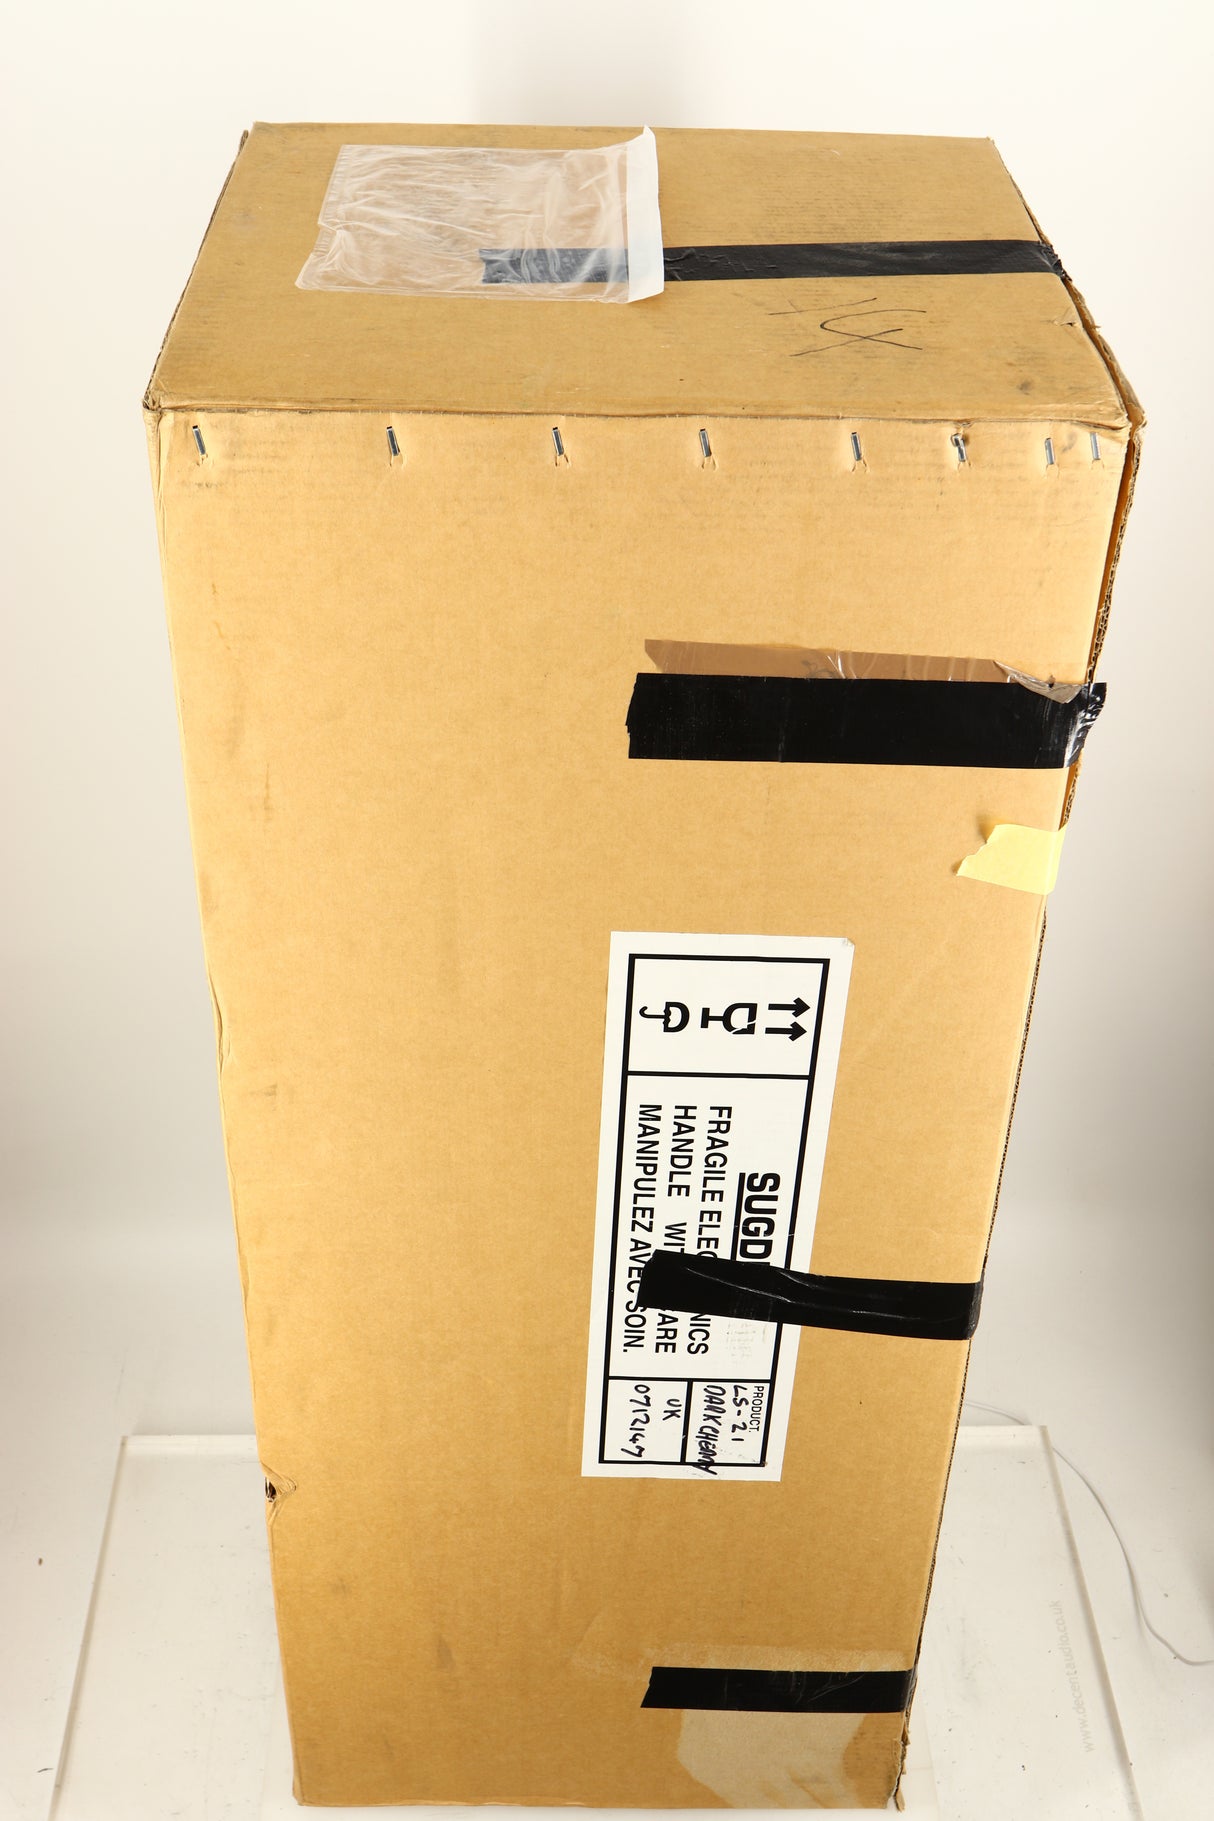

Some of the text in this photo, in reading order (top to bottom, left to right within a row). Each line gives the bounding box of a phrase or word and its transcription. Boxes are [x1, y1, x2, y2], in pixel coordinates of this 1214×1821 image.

[630, 1103, 662, 1233] MANIPULEZ
[667, 1104, 698, 1198] HANDLE
[701, 1105, 733, 1203] FRAGILE
[738, 1172, 781, 1266] SUGD
[622, 1299, 648, 1353] SOIN.
[654, 1308, 679, 1354] ARE
[662, 1398, 682, 1421] UK
[748, 1385, 765, 1433] PRODUCT.
[1049, 1599, 1095, 1753] www.decentaudio.co.uk
